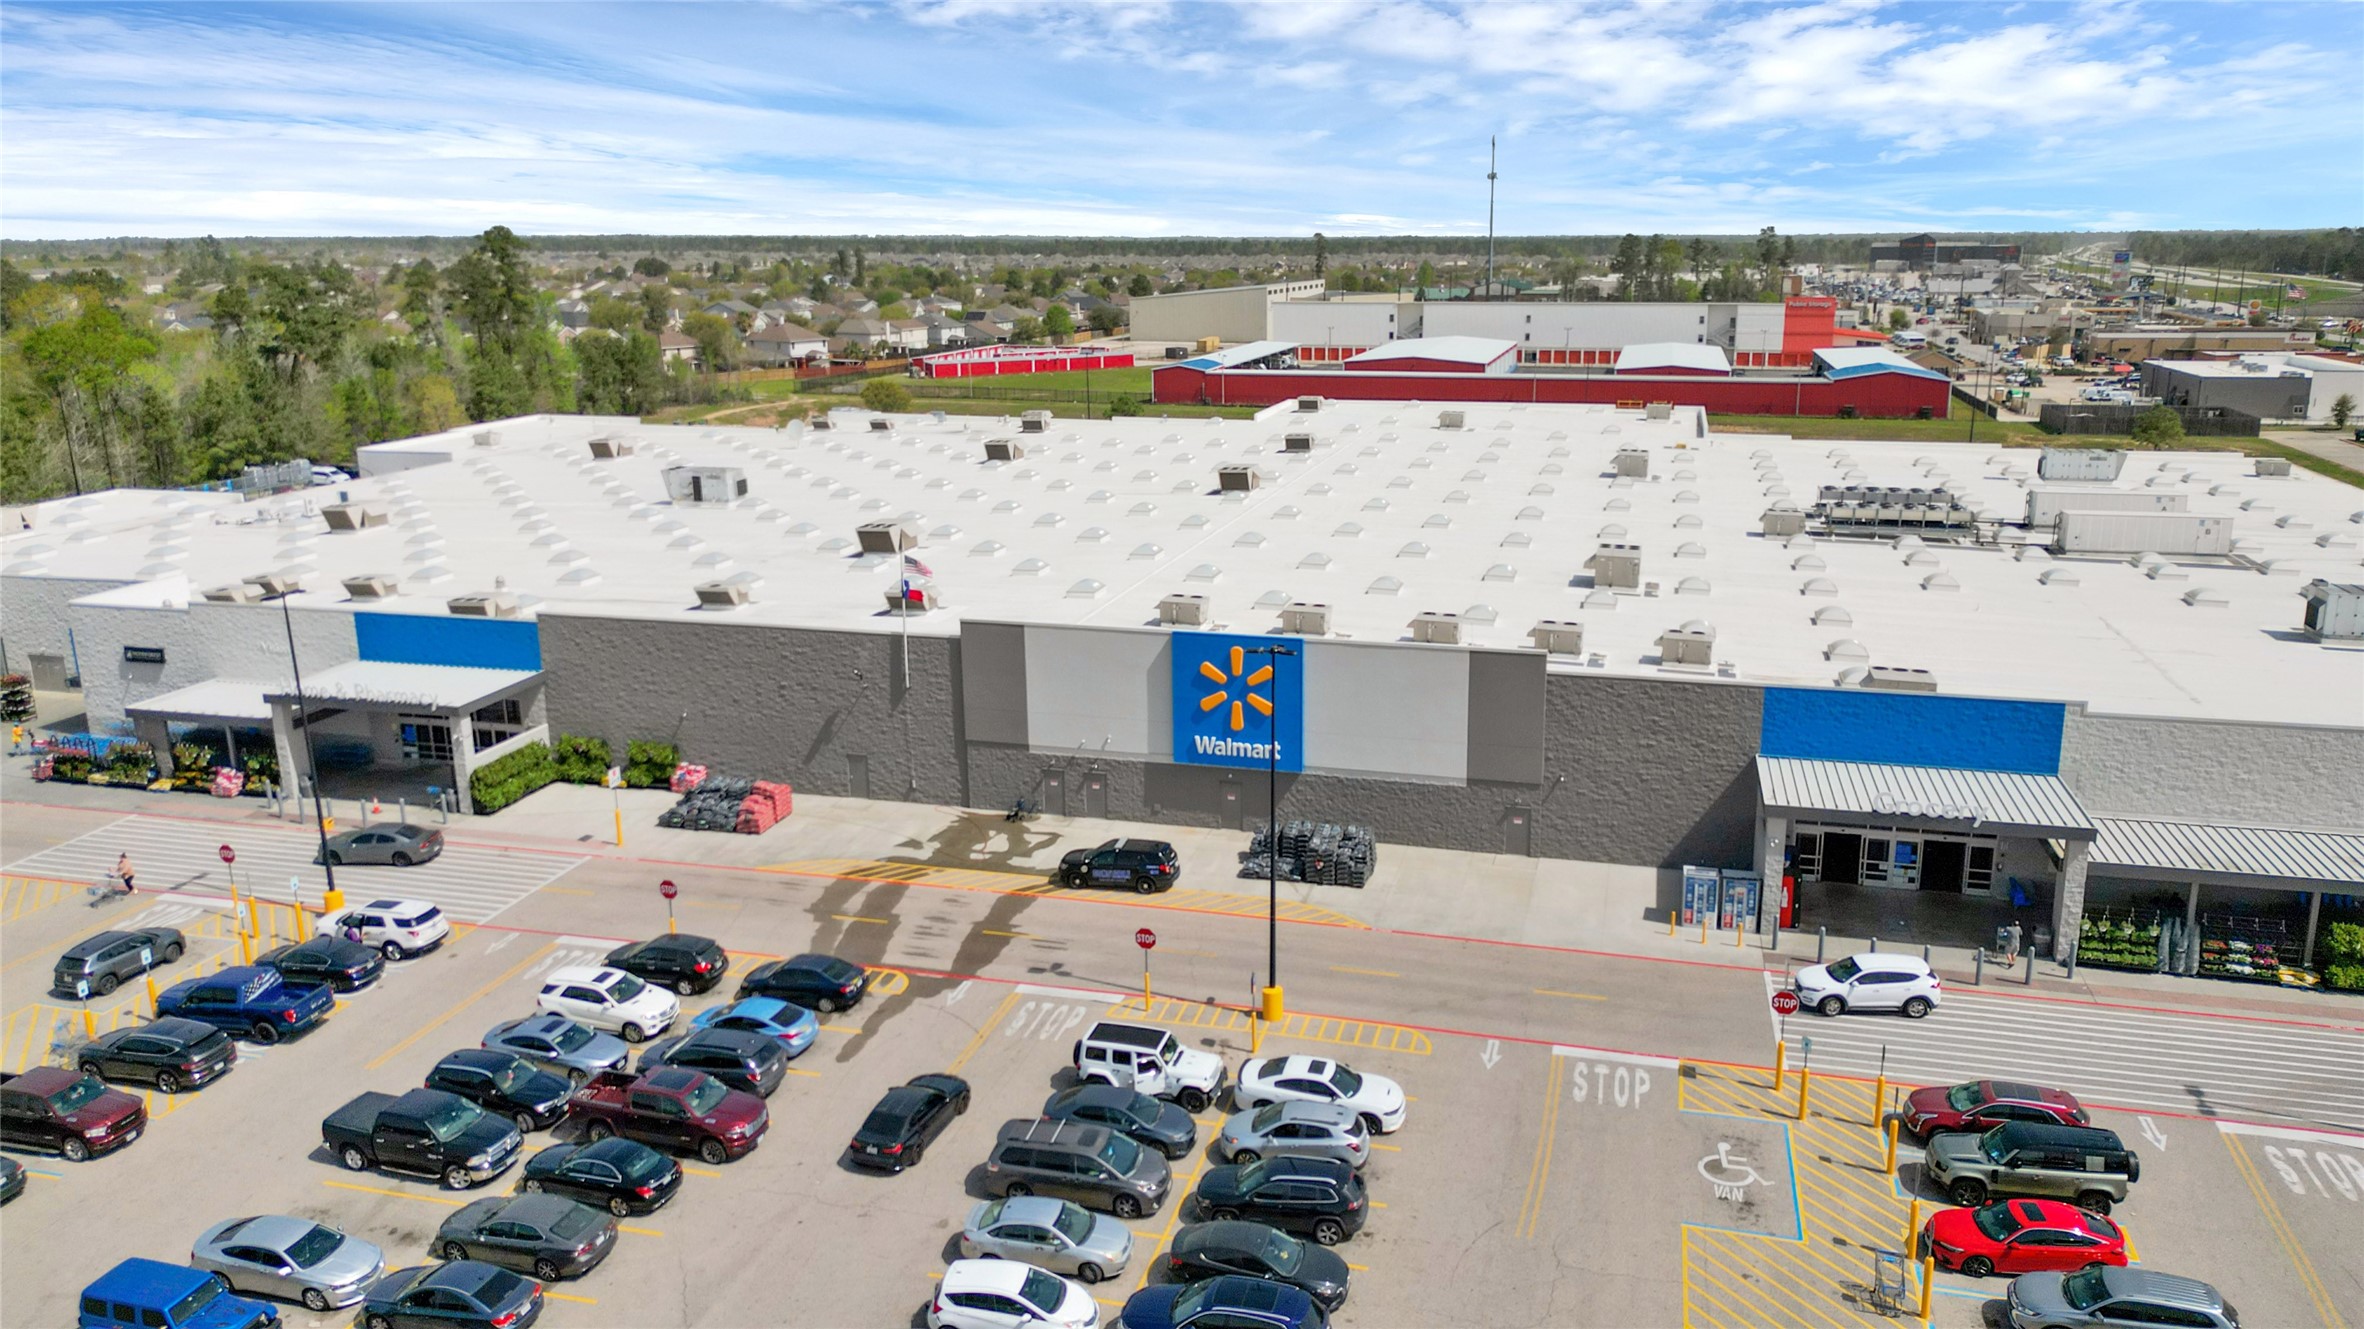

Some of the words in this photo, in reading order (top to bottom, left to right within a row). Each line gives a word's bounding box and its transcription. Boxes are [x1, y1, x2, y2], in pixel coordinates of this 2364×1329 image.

[335, 681, 348, 701] &
[353, 682, 438, 712] Pharmacy
[1194, 735, 1281, 760] Walmart
[1873, 792, 1989, 828] Grocery
[661, 885, 677, 894] STOP
[1136, 934, 1155, 943] STOP
[1773, 998, 1797, 1008] STOP
[1005, 1001, 1086, 1041] STOP
[1573, 1061, 1650, 1109] STOP
[1714, 1184, 1743, 1202] VAN
